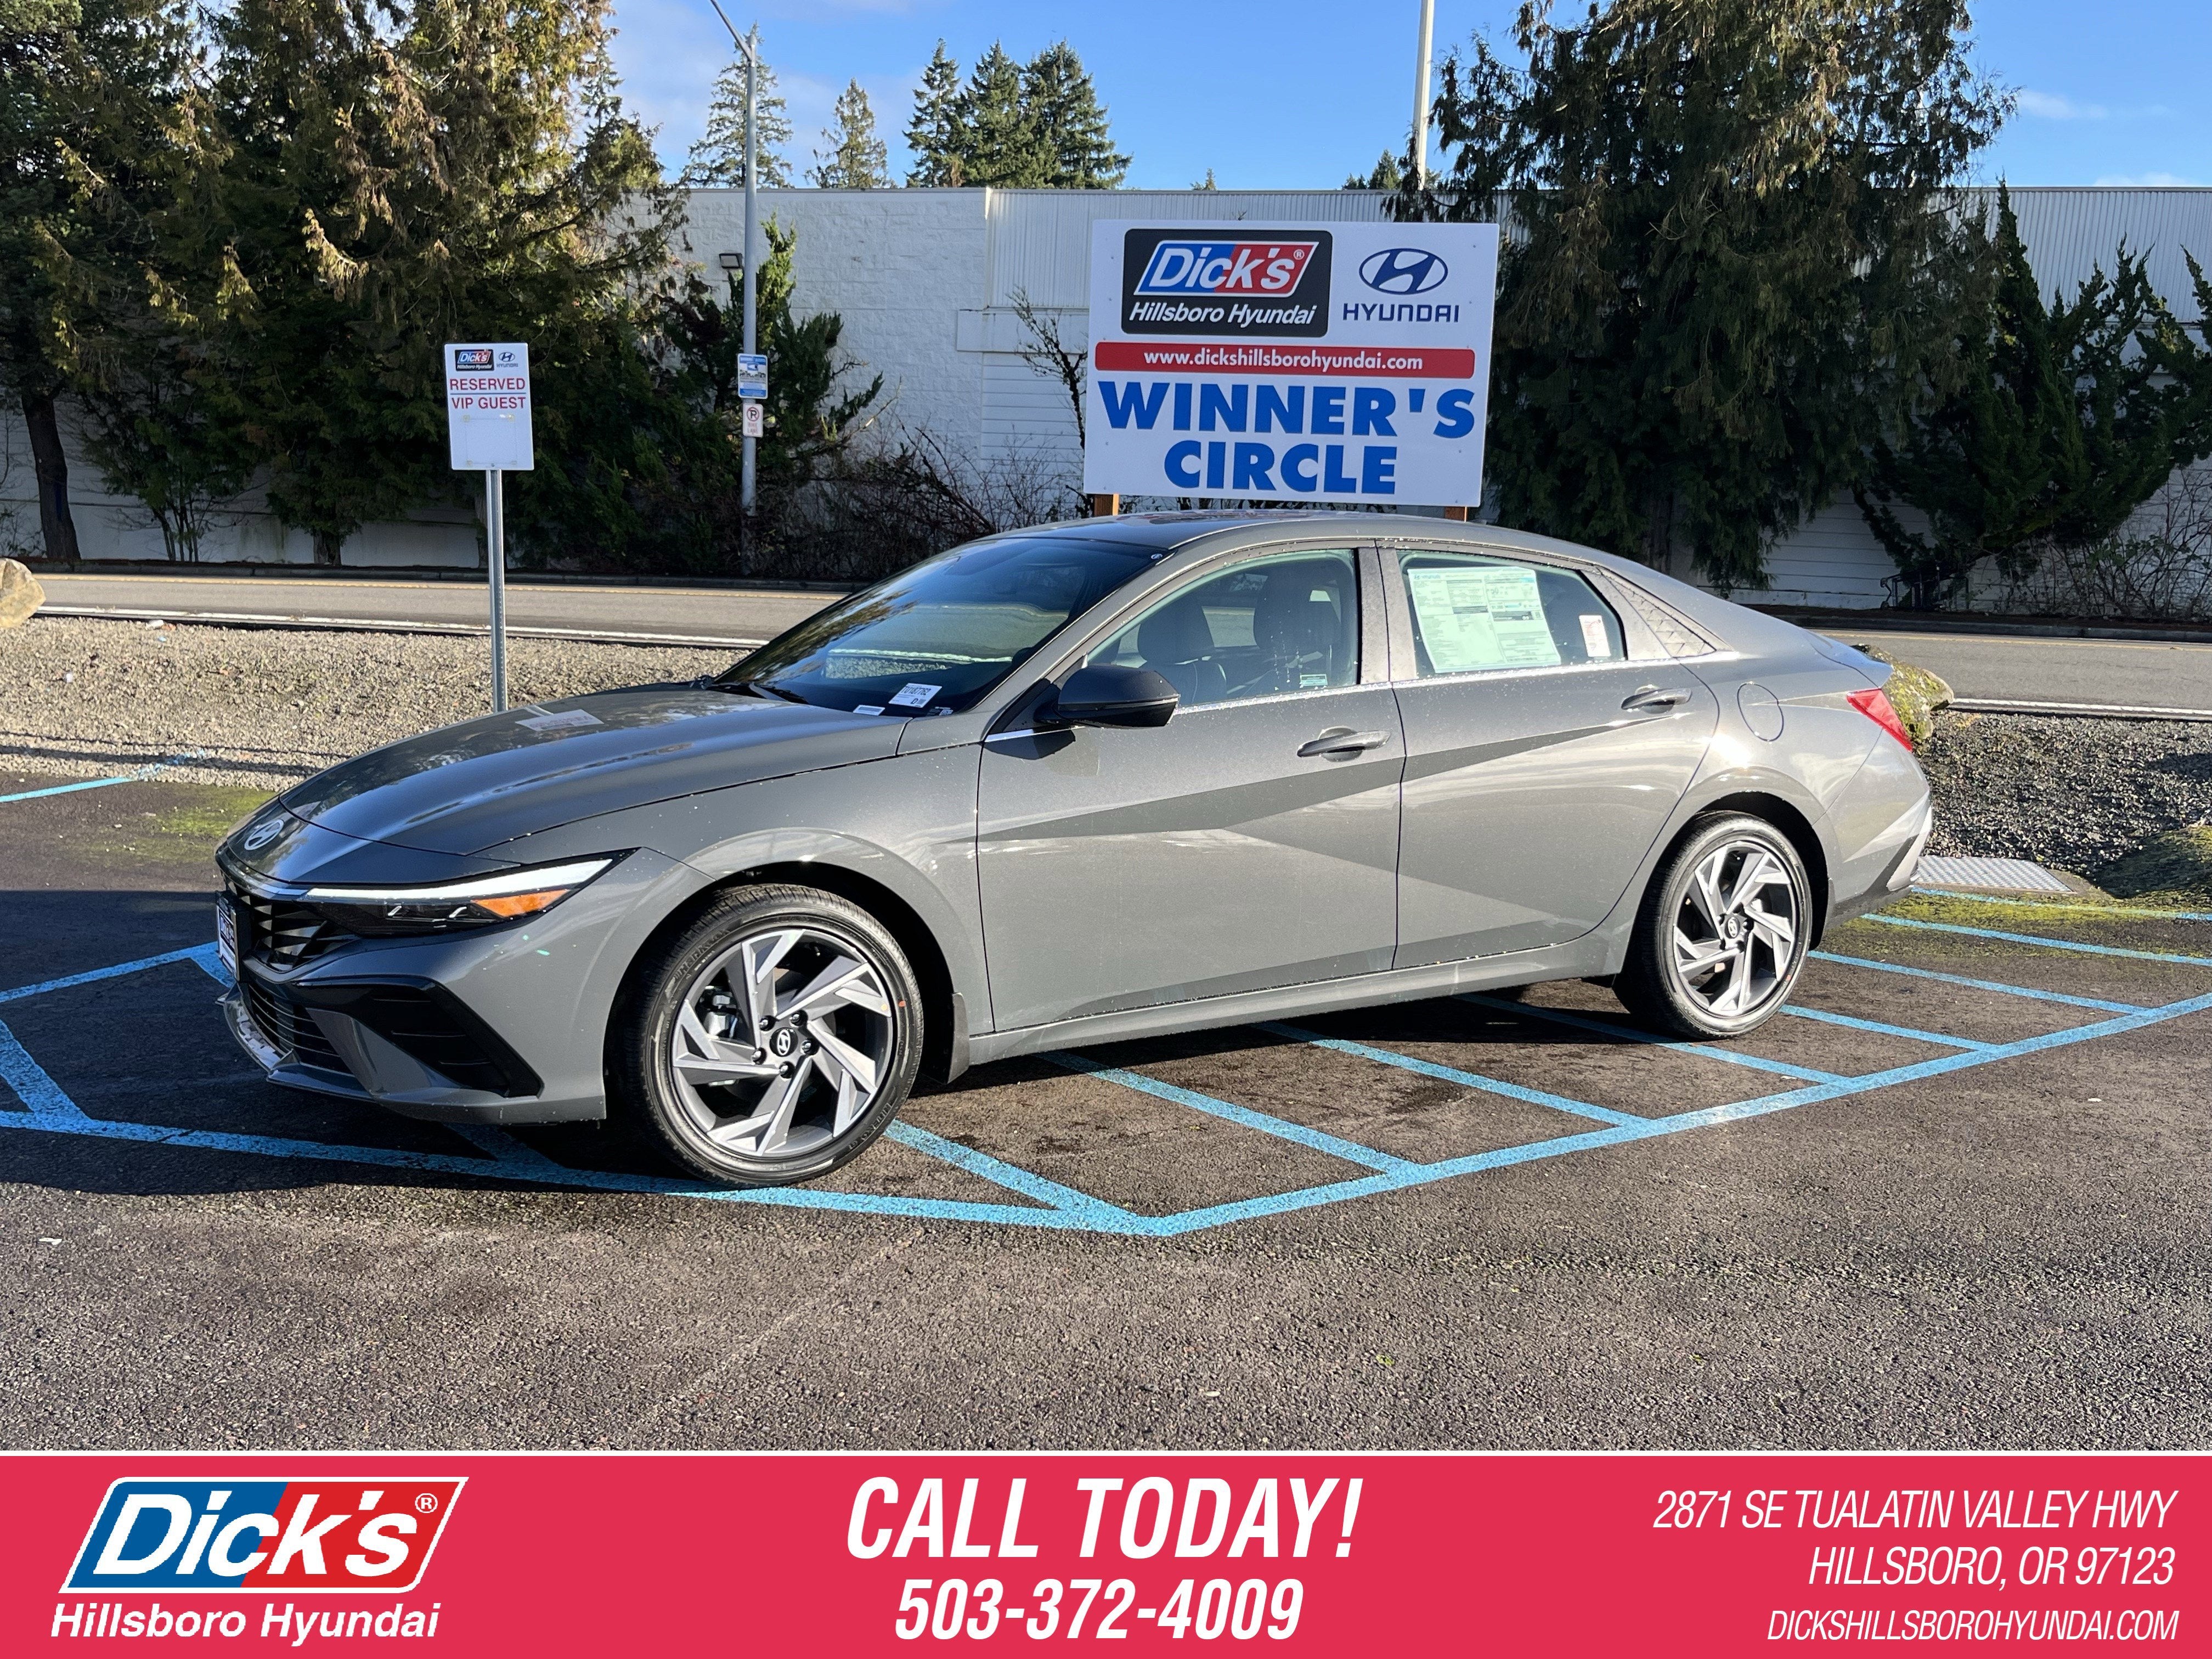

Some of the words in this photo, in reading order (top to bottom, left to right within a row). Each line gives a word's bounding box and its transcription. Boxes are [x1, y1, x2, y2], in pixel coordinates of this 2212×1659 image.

[1129, 302, 1224, 323] Hillsboro
[1227, 303, 1317, 328] Hyundai
[1343, 303, 1459, 323] HYUNDAI
[1144, 348, 1423, 373] www.dickshillsborohyundai.com
[450, 377, 526, 391] RESERVED
[452, 397, 473, 409] VIP
[478, 397, 526, 409] GUEST
[1097, 380, 1476, 439] WINNER'S
[1164, 440, 1398, 495] CIRCLE
